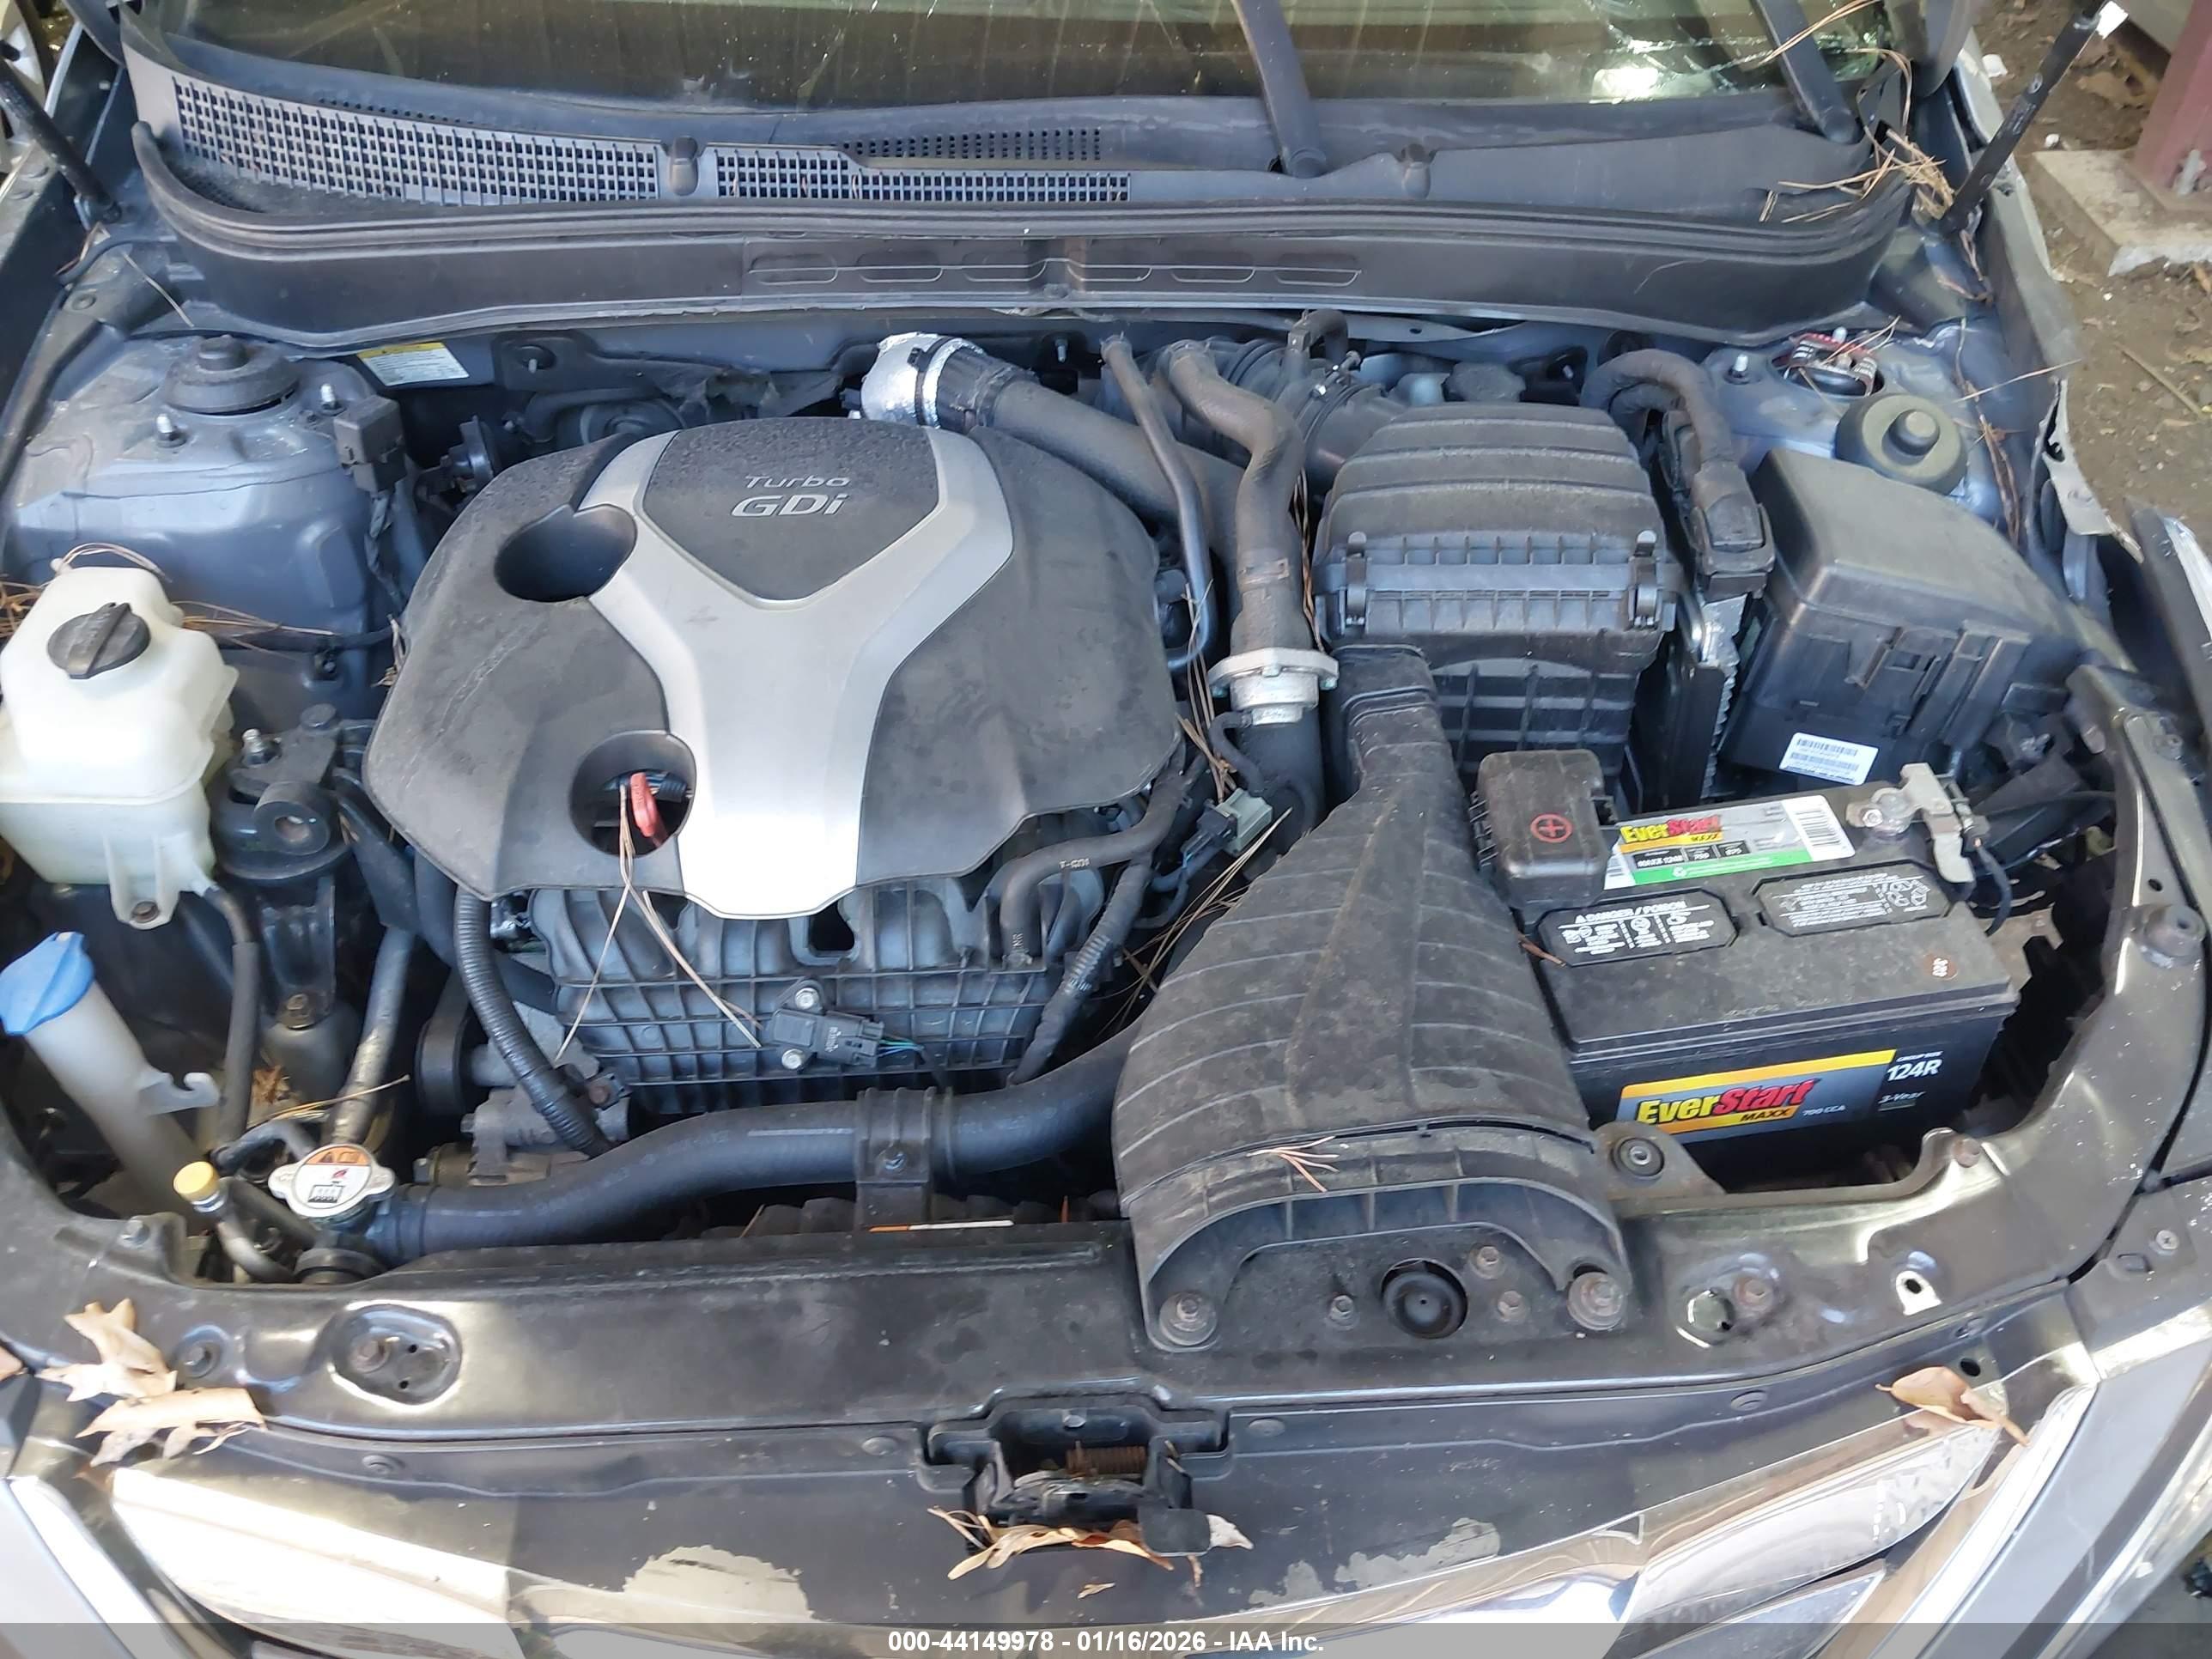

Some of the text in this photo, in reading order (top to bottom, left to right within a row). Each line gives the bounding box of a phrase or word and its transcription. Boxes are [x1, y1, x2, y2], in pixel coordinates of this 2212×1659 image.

[744, 475, 851, 489] Turbo
[731, 493, 849, 517] GDi
[1620, 814, 1723, 843] EverStart
[1887, 1059, 1942, 1082] 124R
[1634, 1078, 1822, 1125] EverStart
[1824, 1105, 1846, 1115] CCA
[1740, 1108, 1790, 1122] MAXX
